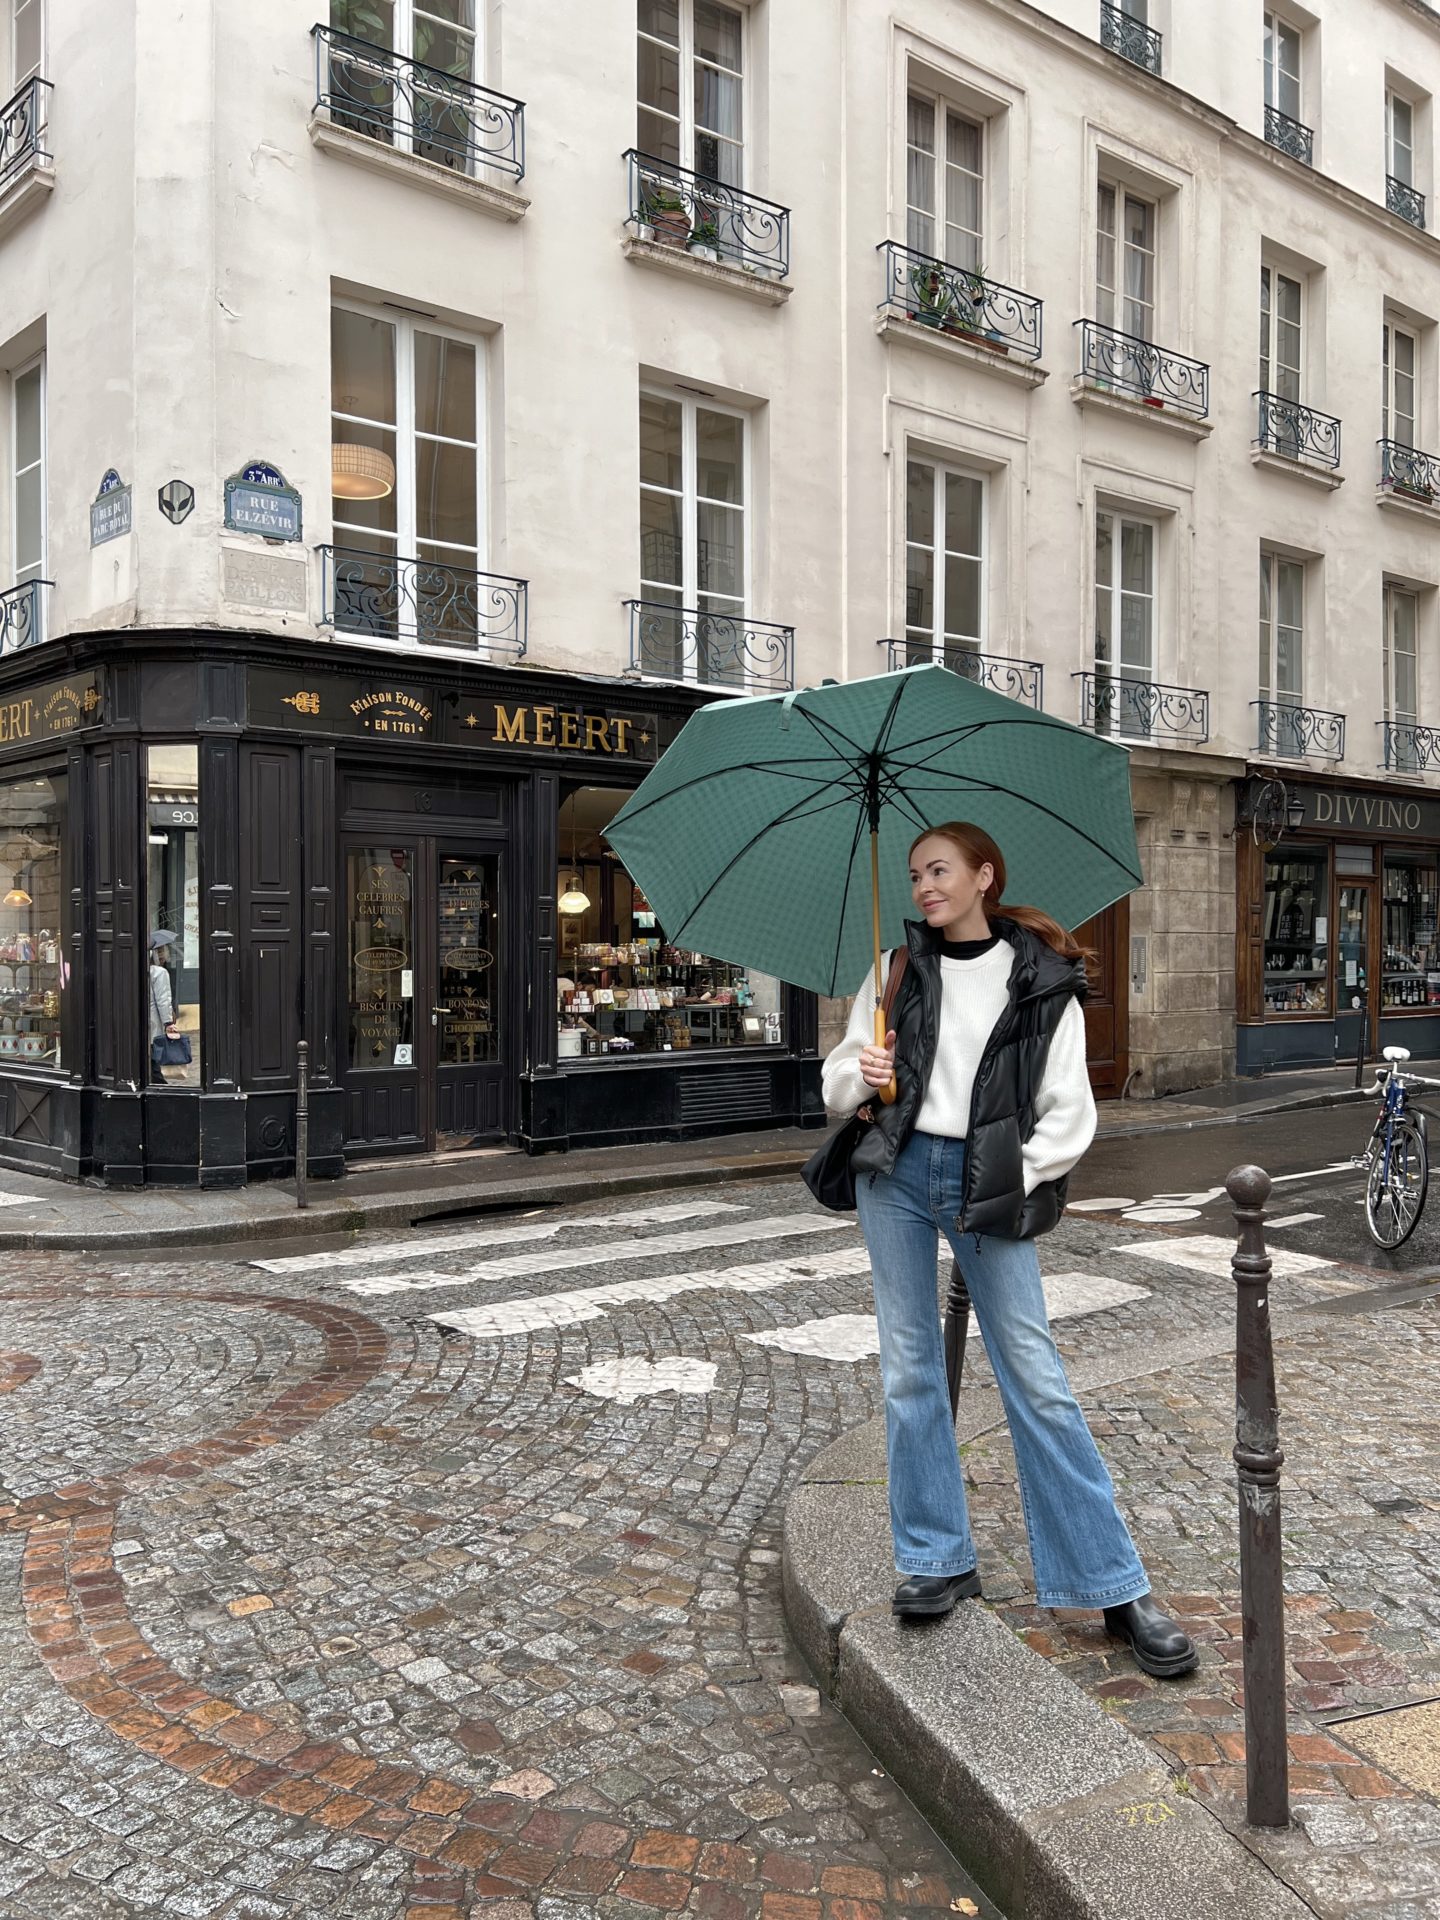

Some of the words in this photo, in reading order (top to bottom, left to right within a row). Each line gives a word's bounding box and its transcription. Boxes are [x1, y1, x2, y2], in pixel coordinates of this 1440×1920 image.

[250, 496, 279, 512] RUE
[235, 509, 292, 529] ELZÉVIR
[374, 719, 388, 731] EN
[391, 720, 416, 734] 1761
[1313, 792, 1421, 830] DIVVINO
[371, 879, 389, 889] SES
[359, 905, 403, 915] GAUFRES
[360, 1001, 403, 1012] BISCUITS
[374, 1014, 389, 1024] DE
[361, 1027, 401, 1037] VOYAGE
